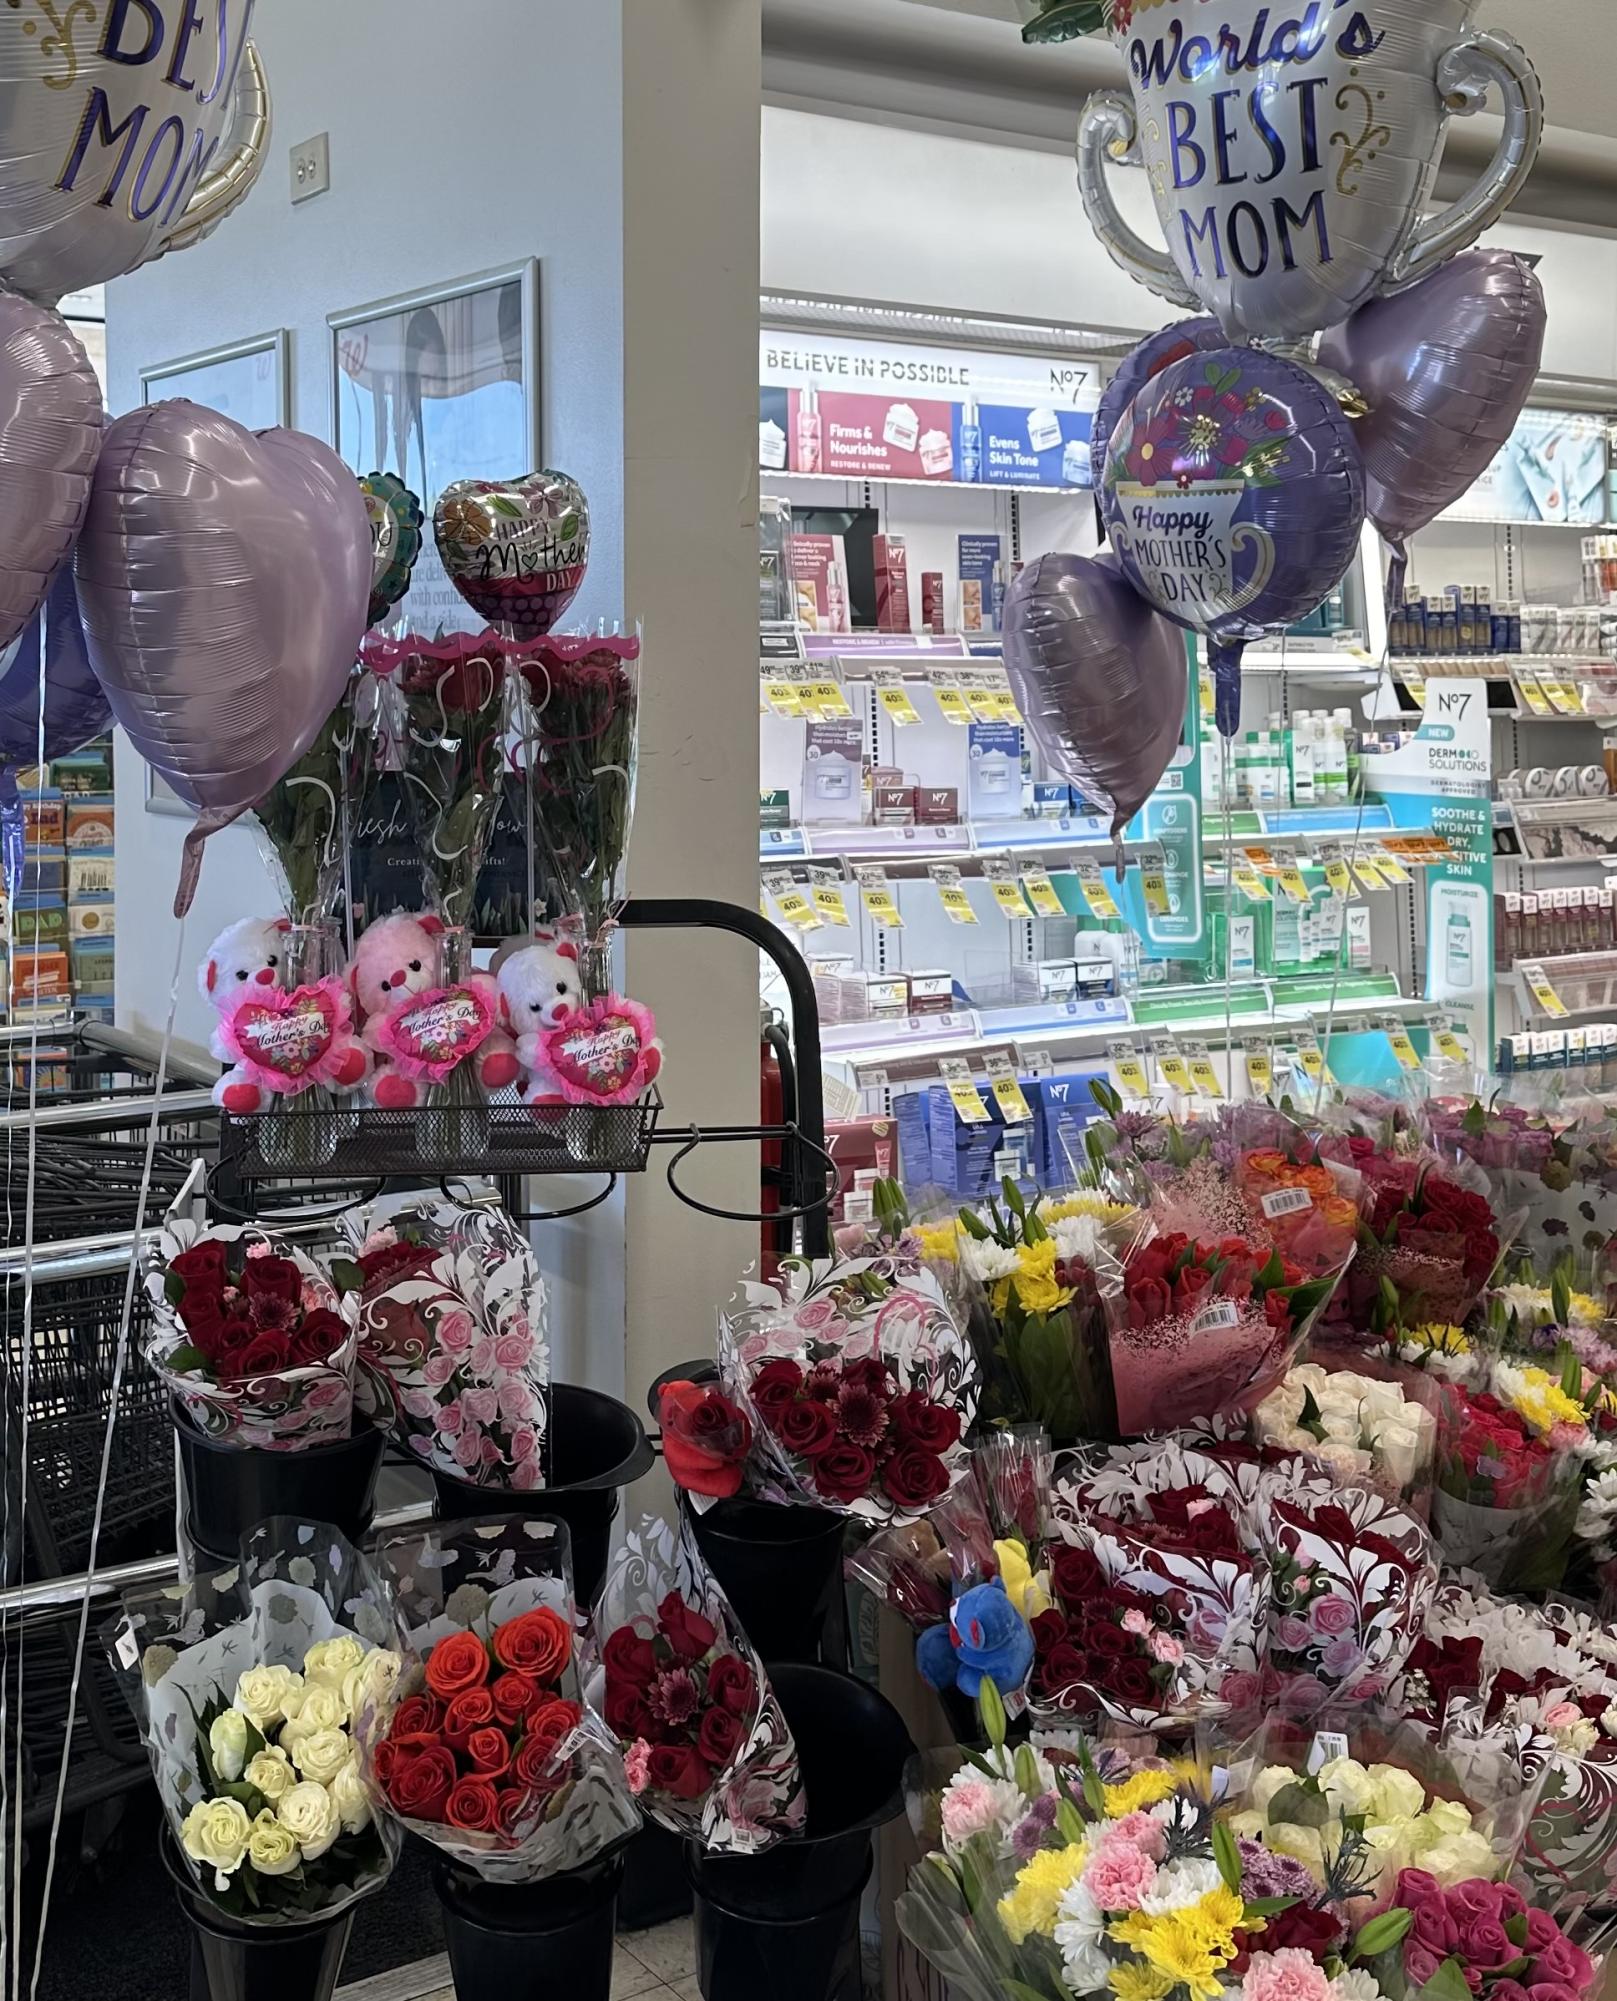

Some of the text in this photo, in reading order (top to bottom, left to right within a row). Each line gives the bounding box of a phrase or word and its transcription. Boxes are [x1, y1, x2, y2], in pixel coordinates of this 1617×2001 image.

[1129, 0, 1386, 92] World's
[1164, 76, 1329, 190] BEST
[54, 86, 220, 228] MOM
[1178, 189, 1333, 280] MOM
[880, 360, 970, 386] POSSIBLE
[829, 423, 873, 440] Firms &
[830, 440, 888, 457] Nourishes
[989, 435, 1020, 451] Evens
[989, 451, 1039, 467] Skin Tone
[1132, 505, 1214, 539] Happy
[1135, 534, 1227, 570] MOTHER'S
[546, 570, 574, 592] DAY
[1161, 571, 1210, 602] DAY
[1429, 759, 1487, 772] SOLUTIONS
[1432, 806, 1486, 821] SOOTHE &
[1433, 820, 1484, 835] HYDRATE
[1447, 835, 1471, 849] DRY,
[1446, 864, 1472, 876] SKIN
